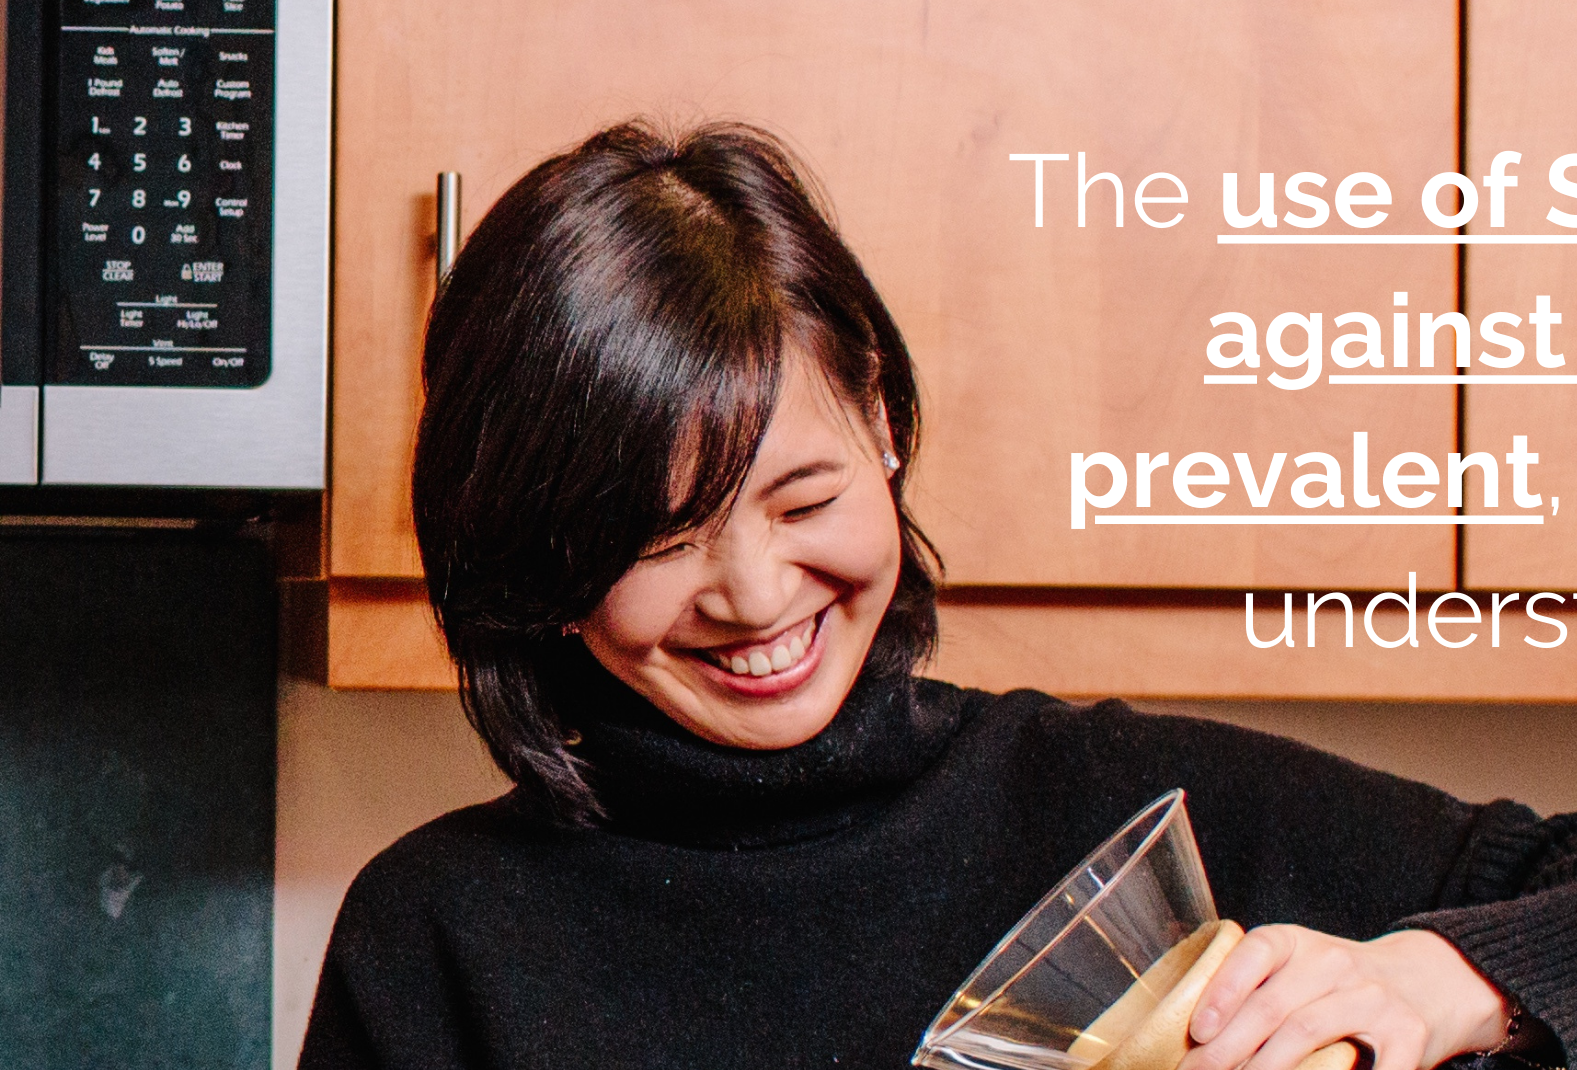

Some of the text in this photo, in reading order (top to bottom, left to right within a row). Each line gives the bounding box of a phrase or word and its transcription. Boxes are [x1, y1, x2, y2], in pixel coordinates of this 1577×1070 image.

[129, 25, 210, 38] Automatic Cooking
[219, 52, 248, 61] Snacks
[94, 78, 123, 88] Pound
[158, 79, 179, 88] Auto
[216, 79, 249, 88] Custom
[89, 88, 120, 96] Defrost
[153, 88, 183, 97] Defrost
[214, 89, 251, 100] Program
[92, 116, 99, 133] 1
[133, 117, 147, 135] 2
[179, 117, 191, 136] 3
[216, 122, 249, 131] Kitchen
[221, 131, 244, 140] Timer
[89, 153, 101, 170] 4
[134, 153, 146, 171] 5
[178, 154, 191, 172] 6
[219, 160, 242, 170] Clock
[89, 189, 100, 207] 7
[133, 189, 146, 208] 8
[177, 190, 191, 208] 9
[216, 198, 247, 207] Control
[220, 207, 244, 217] Setup
[82, 222, 109, 232] Power
[176, 225, 195, 233] Add
[84, 232, 107, 242] Level
[132, 226, 146, 244] 0
[171, 233, 183, 243] 30
[106, 261, 132, 270] STOP
[193, 262, 224, 272] ENTER
[102, 271, 134, 282] CLEAR
[193, 273, 223, 282] START
[156, 295, 177, 303] Light
[121, 310, 143, 320] Light
[186, 311, 209, 321] Light
[153, 339, 174, 347] Vent
[90, 352, 114, 363] Delay
[156, 356, 183, 366] Speed
[213, 357, 244, 367] On/Off
[95, 361, 109, 370] Off
